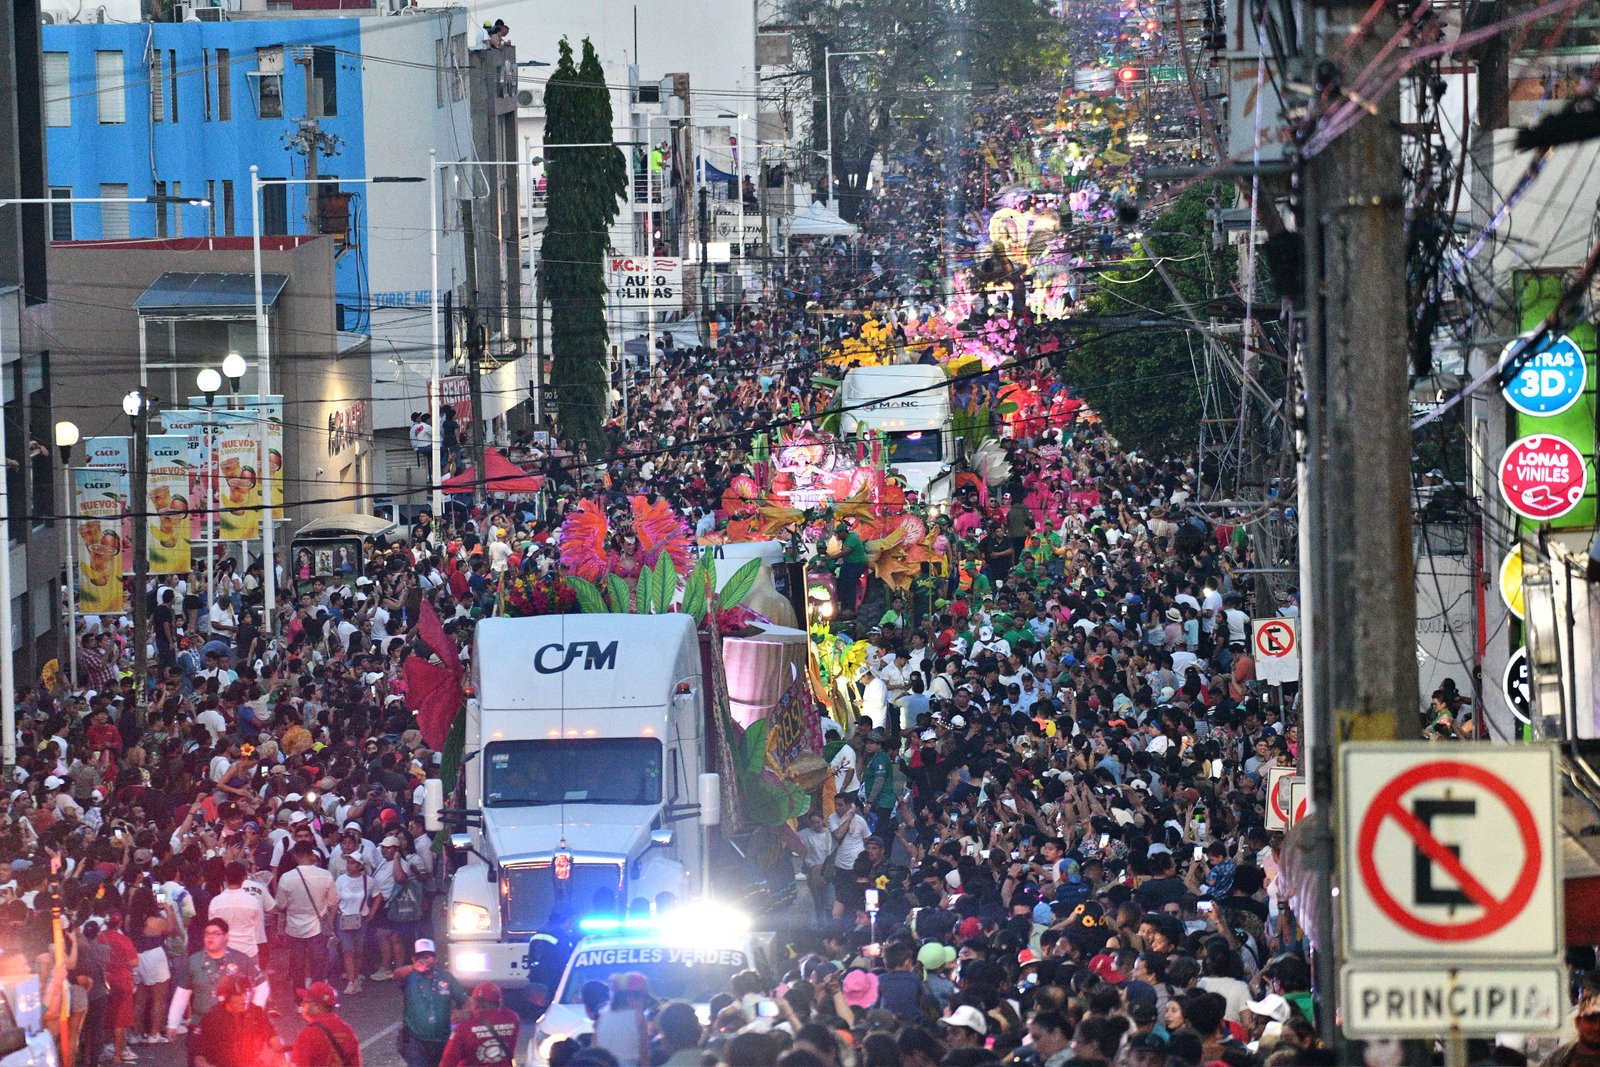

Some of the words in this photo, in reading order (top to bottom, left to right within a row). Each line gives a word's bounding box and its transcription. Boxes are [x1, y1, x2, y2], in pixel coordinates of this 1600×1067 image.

[373, 292, 411, 306] TORRE
[1520, 369, 1566, 398] 3D
[221, 440, 255, 449] NUEVOS
[1518, 452, 1569, 467] LONAS
[1516, 466, 1570, 483] VINILES
[533, 640, 619, 675] CFM
[575, 949, 663, 967] ANGELES
[668, 949, 744, 967] VERDES
